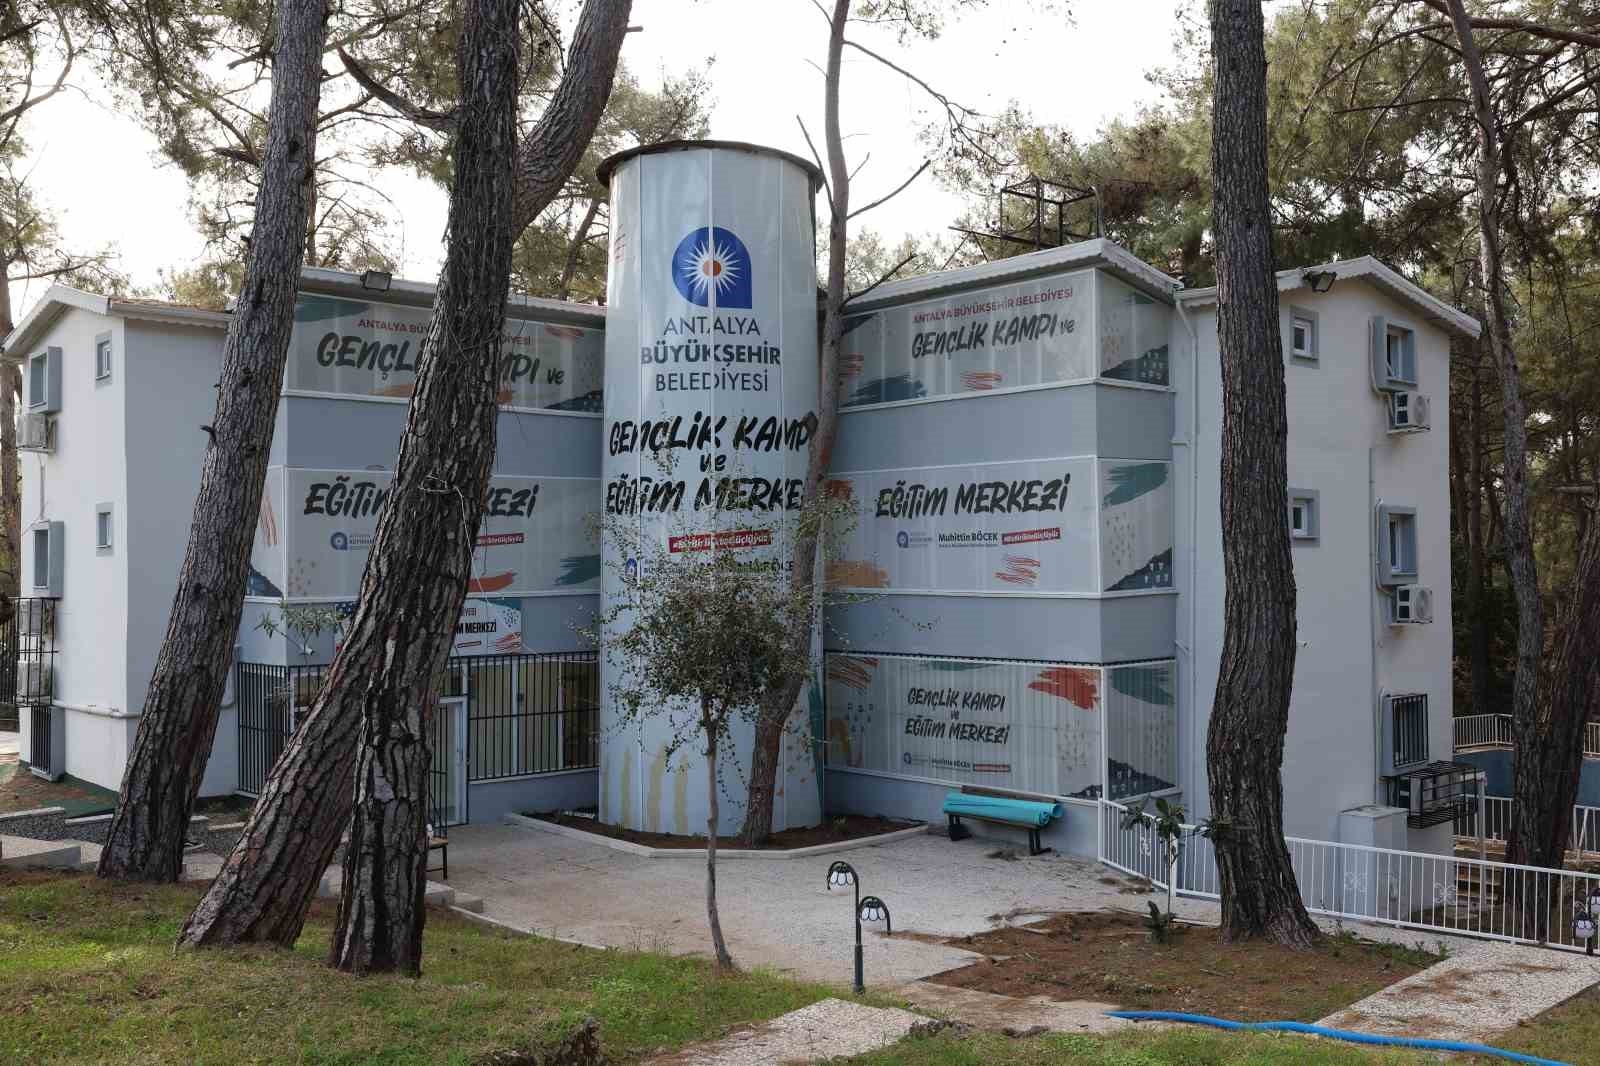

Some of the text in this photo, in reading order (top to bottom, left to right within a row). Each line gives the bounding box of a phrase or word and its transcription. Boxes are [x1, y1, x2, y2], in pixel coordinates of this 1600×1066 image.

[663, 315, 761, 336] ANTALYA
[912, 309, 952, 324] ANTALYA
[911, 321, 988, 360] GENÇLİK
[991, 312, 1059, 347] KAMPI
[640, 338, 781, 367] BÜYÜKŞEHİR
[547, 367, 565, 385] ve
[655, 367, 768, 392] BELEDİYESİ
[733, 411, 814, 452] KAMP
[700, 454, 726, 472] ve
[693, 477, 804, 512] MERKE
[875, 473, 1071, 519] EĞİTİM MERKEZİ
[971, 530, 998, 542] BÖCEK
[907, 687, 1006, 712] GENÇLİK KAMPI
[904, 715, 1011, 744] EĞİTİM MERKEZİ
